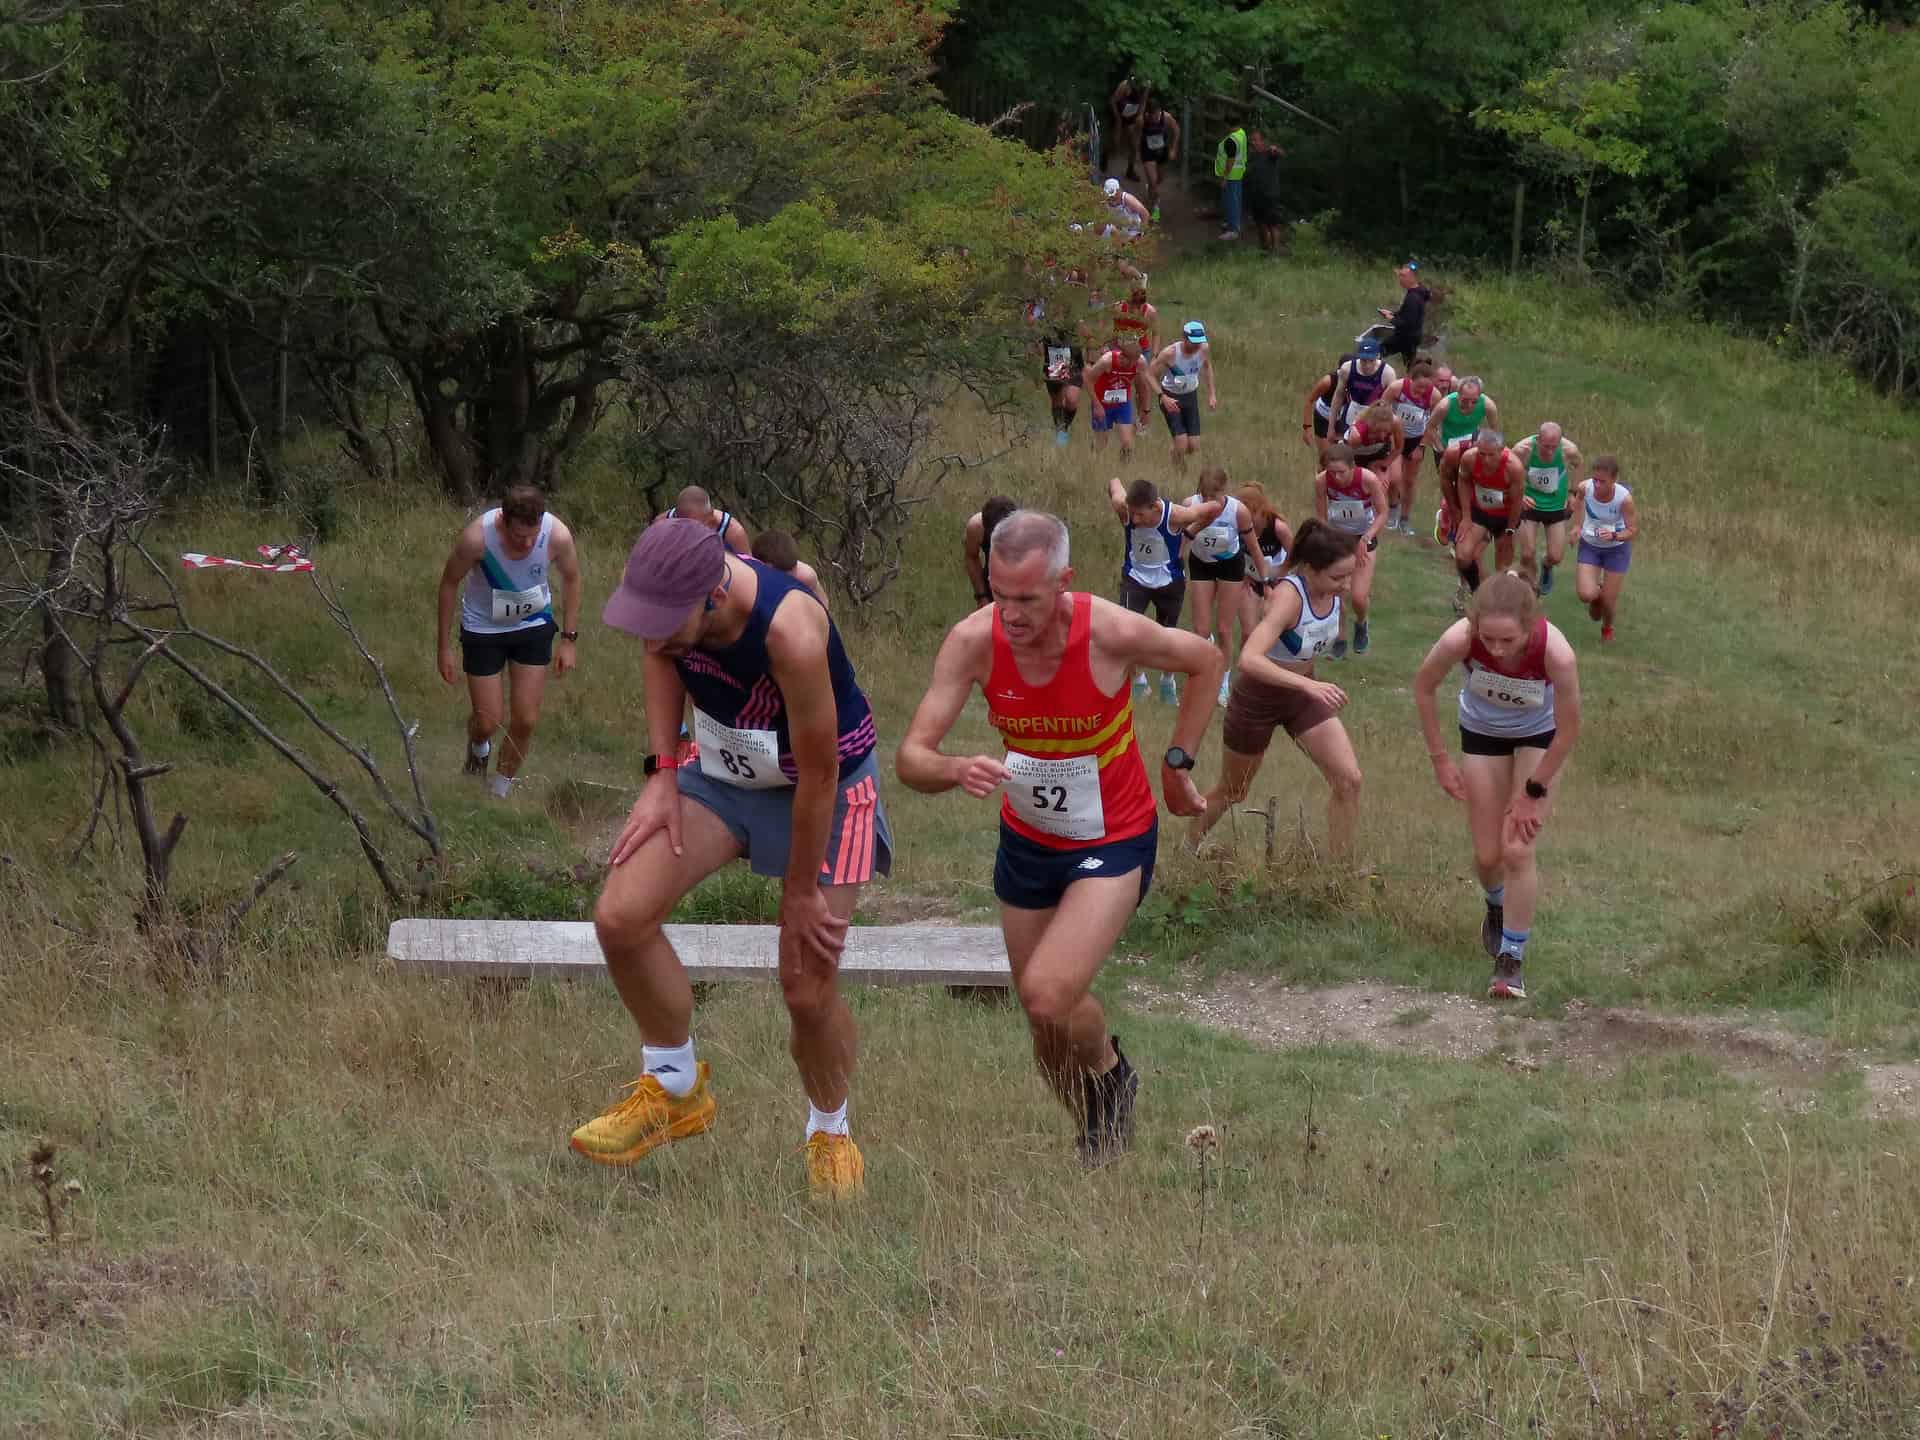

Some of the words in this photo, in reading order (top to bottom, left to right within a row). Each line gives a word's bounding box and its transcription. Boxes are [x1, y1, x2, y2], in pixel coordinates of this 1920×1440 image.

[1537, 476, 1549, 485] 20
[1204, 537, 1217, 547] 57
[1139, 543, 1152, 554] 76
[506, 603, 532, 617] 112
[719, 748, 756, 779] 85
[1032, 785, 1068, 813] 52
